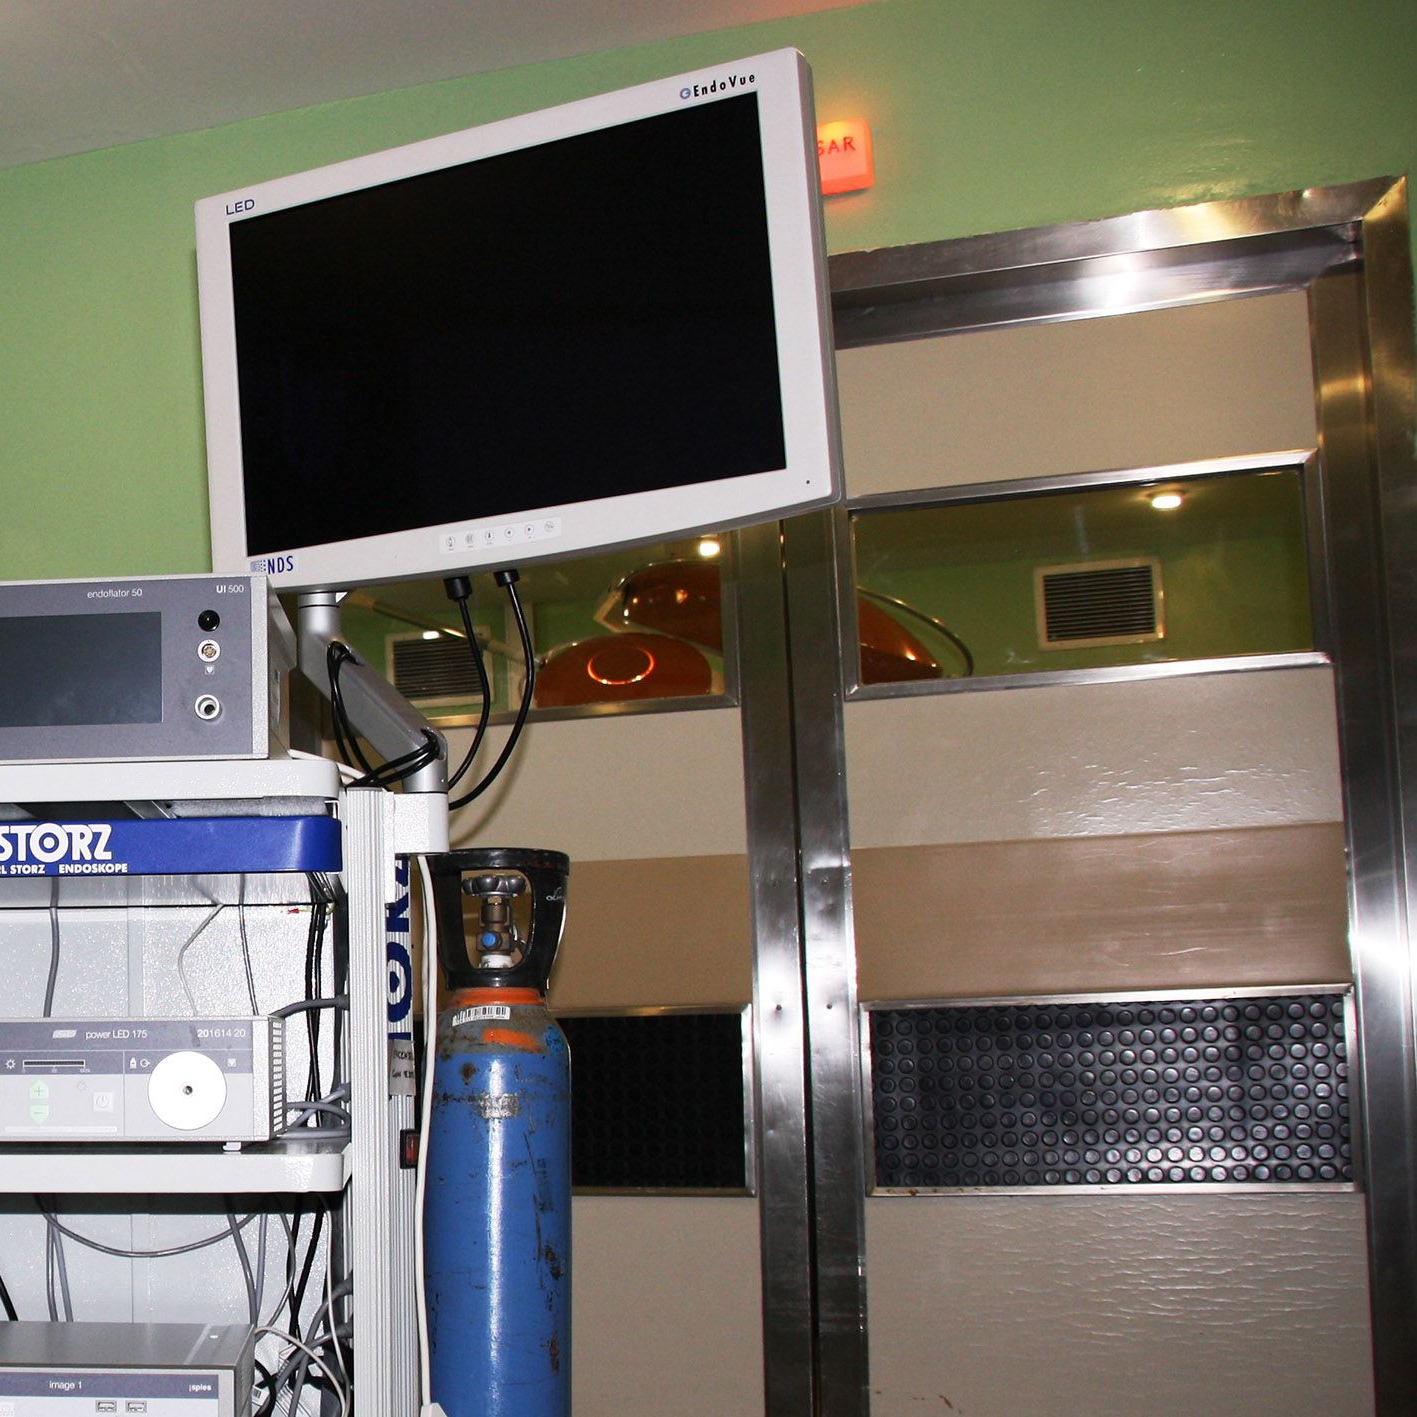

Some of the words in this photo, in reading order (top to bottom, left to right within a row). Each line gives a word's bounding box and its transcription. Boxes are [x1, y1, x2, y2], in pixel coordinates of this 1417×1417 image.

[693, 73, 756, 97] EndoVue
[225, 199, 255, 215] LED
[268, 555, 294, 575] NDS
[87, 588, 130, 599] endoflator
[131, 588, 143, 597] 50
[216, 585, 227, 594] UI
[228, 584, 244, 593] 500
[10, 864, 45, 874] STORZ
[59, 863, 128, 874] ENDOSKOPE
[85, 1031, 111, 1040] power
[112, 1029, 130, 1039] LED
[132, 1029, 148, 1039] 175
[197, 1029, 232, 1038] 201614
[234, 1029, 246, 1037] 20
[49, 1380, 75, 1390] image
